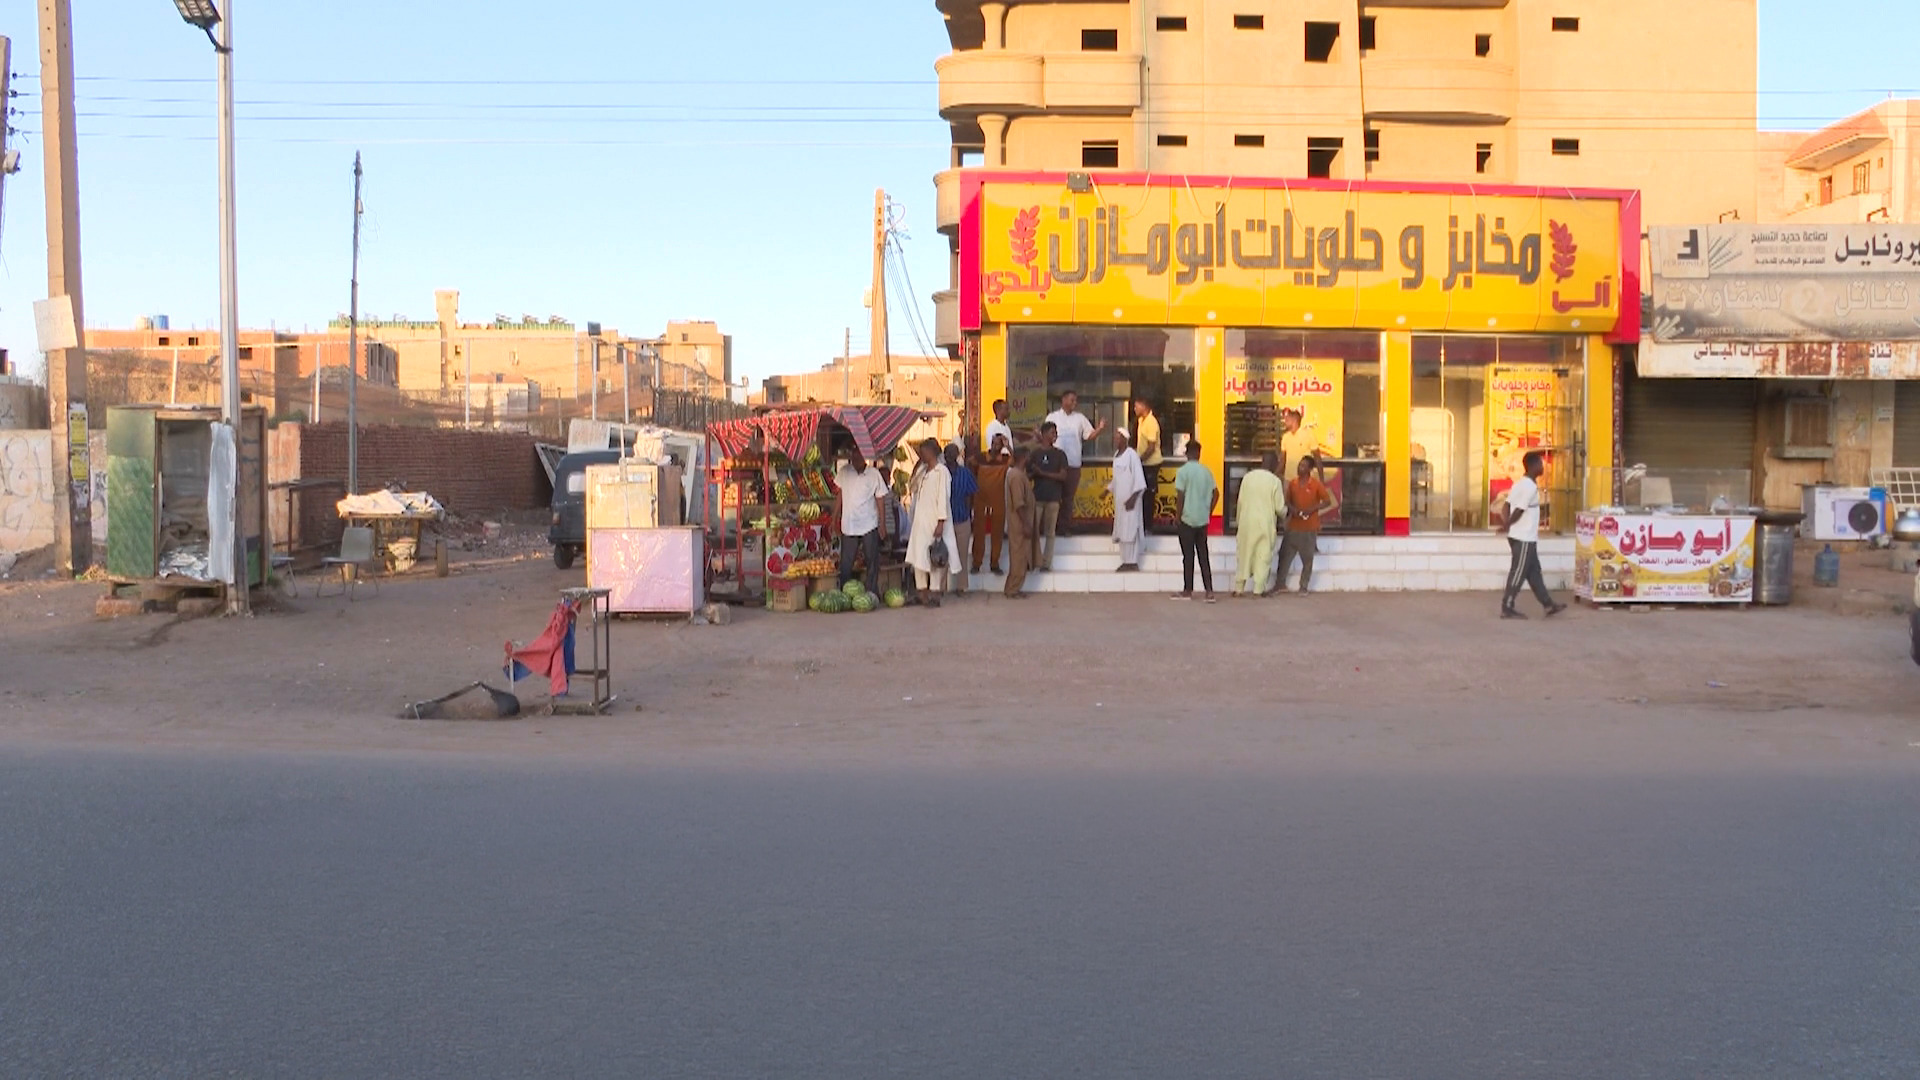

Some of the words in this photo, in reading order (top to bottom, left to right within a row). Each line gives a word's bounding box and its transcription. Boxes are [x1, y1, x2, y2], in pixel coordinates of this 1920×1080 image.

[1231, 208, 1384, 288] حلويات
[1399, 225, 1425, 291] و
[1441, 213, 1542, 292] مخابز
[1834, 232, 1920, 266] يرونايل
[983, 265, 1051, 304] بلدي
[1665, 280, 1783, 318] للمقاولات
[1291, 376, 1332, 397] مخابز
[1619, 522, 1686, 557] مازن
[1690, 517, 1732, 557] أبو
